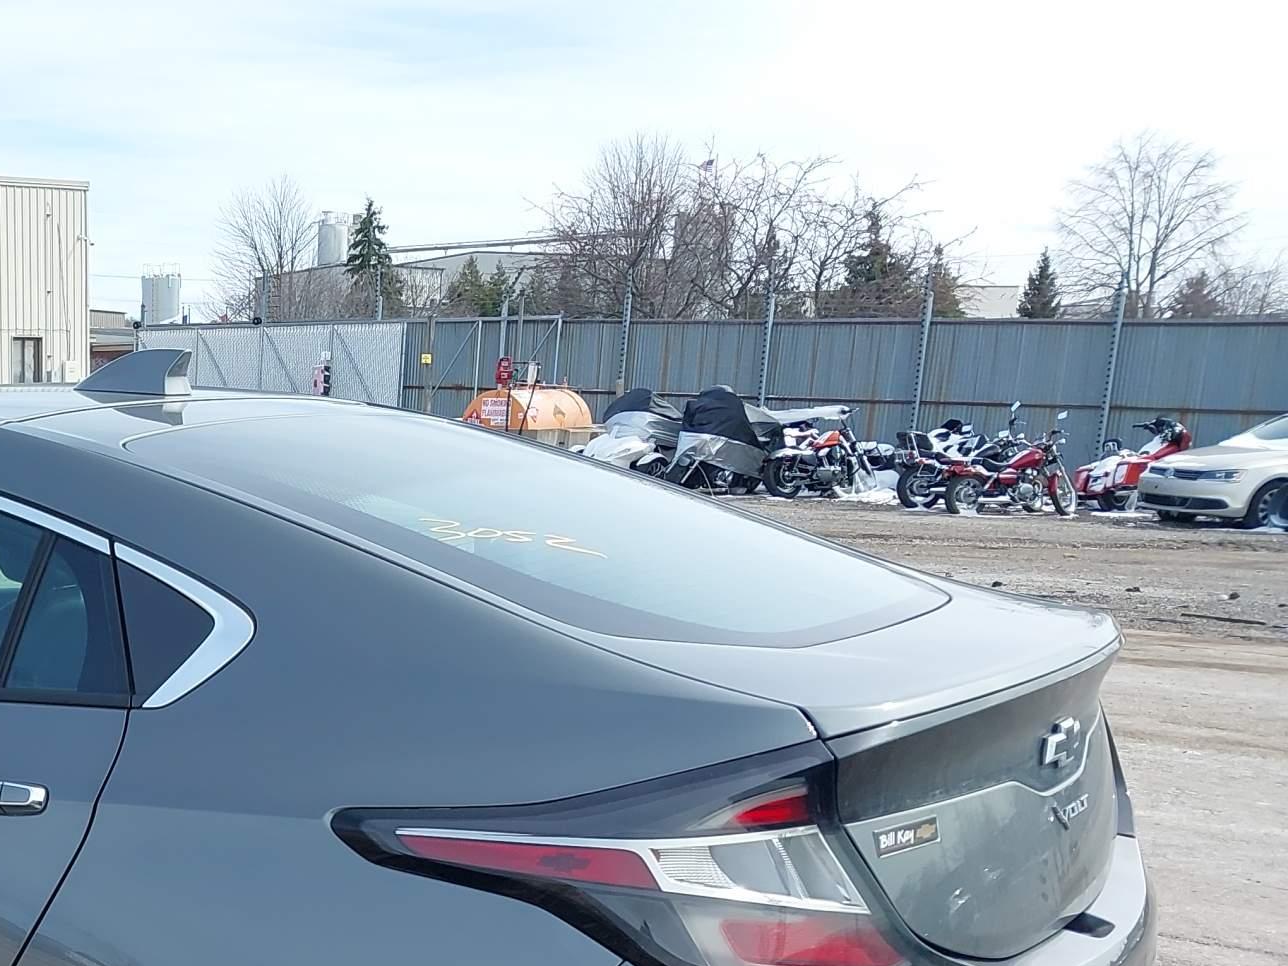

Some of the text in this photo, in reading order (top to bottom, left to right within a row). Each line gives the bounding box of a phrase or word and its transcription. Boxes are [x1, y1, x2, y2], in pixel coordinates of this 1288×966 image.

[418, 517, 608, 560] 3052
[1051, 794, 1089, 830] VOLT
[879, 831, 896, 849] Bill
